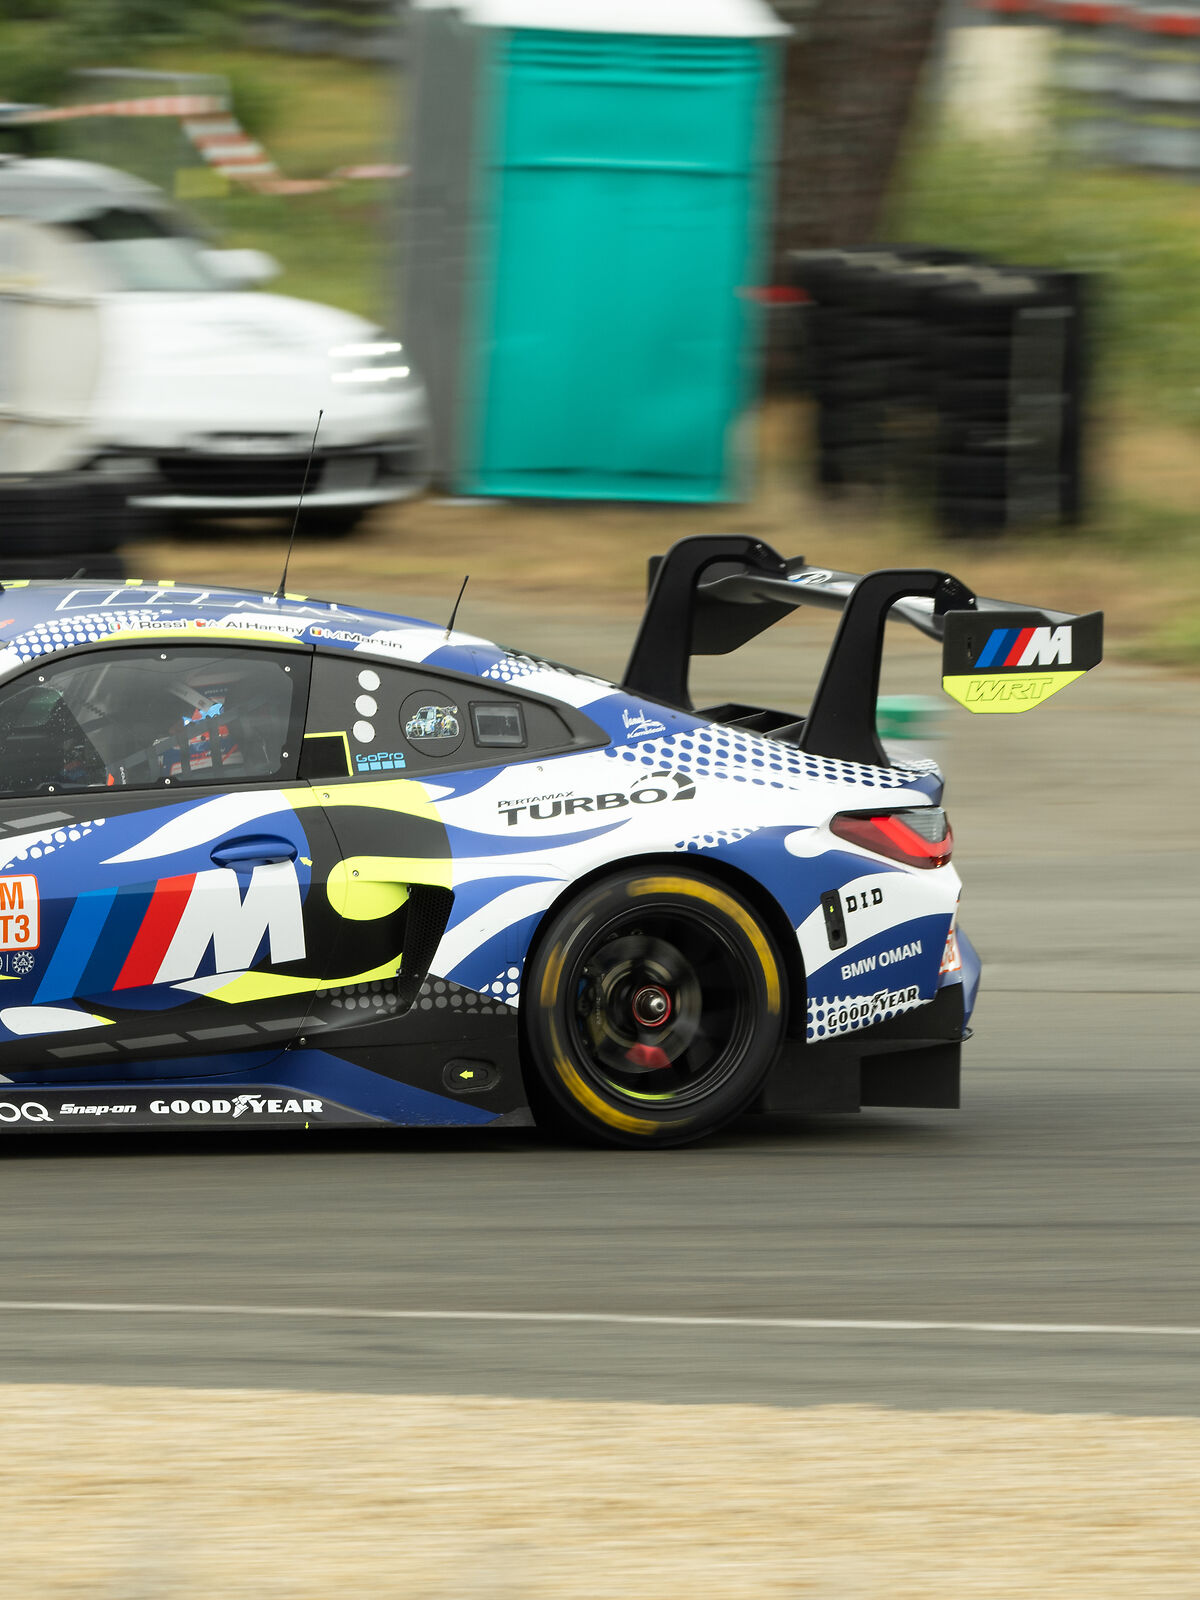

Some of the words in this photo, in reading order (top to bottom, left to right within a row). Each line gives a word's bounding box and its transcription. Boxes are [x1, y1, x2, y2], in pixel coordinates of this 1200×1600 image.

[139, 620, 187, 629] Rossi
[246, 622, 304, 635] Harthy
[344, 633, 403, 649] Martin
[965, 677, 1054, 702] WRT
[355, 752, 405, 764] GoPro
[497, 790, 575, 808] PERTAMAX
[498, 788, 669, 827] TURBO
[840, 955, 877, 981] BMW
[878, 939, 923, 967] OMAN
[59, 1103, 138, 1116] Snap-on
